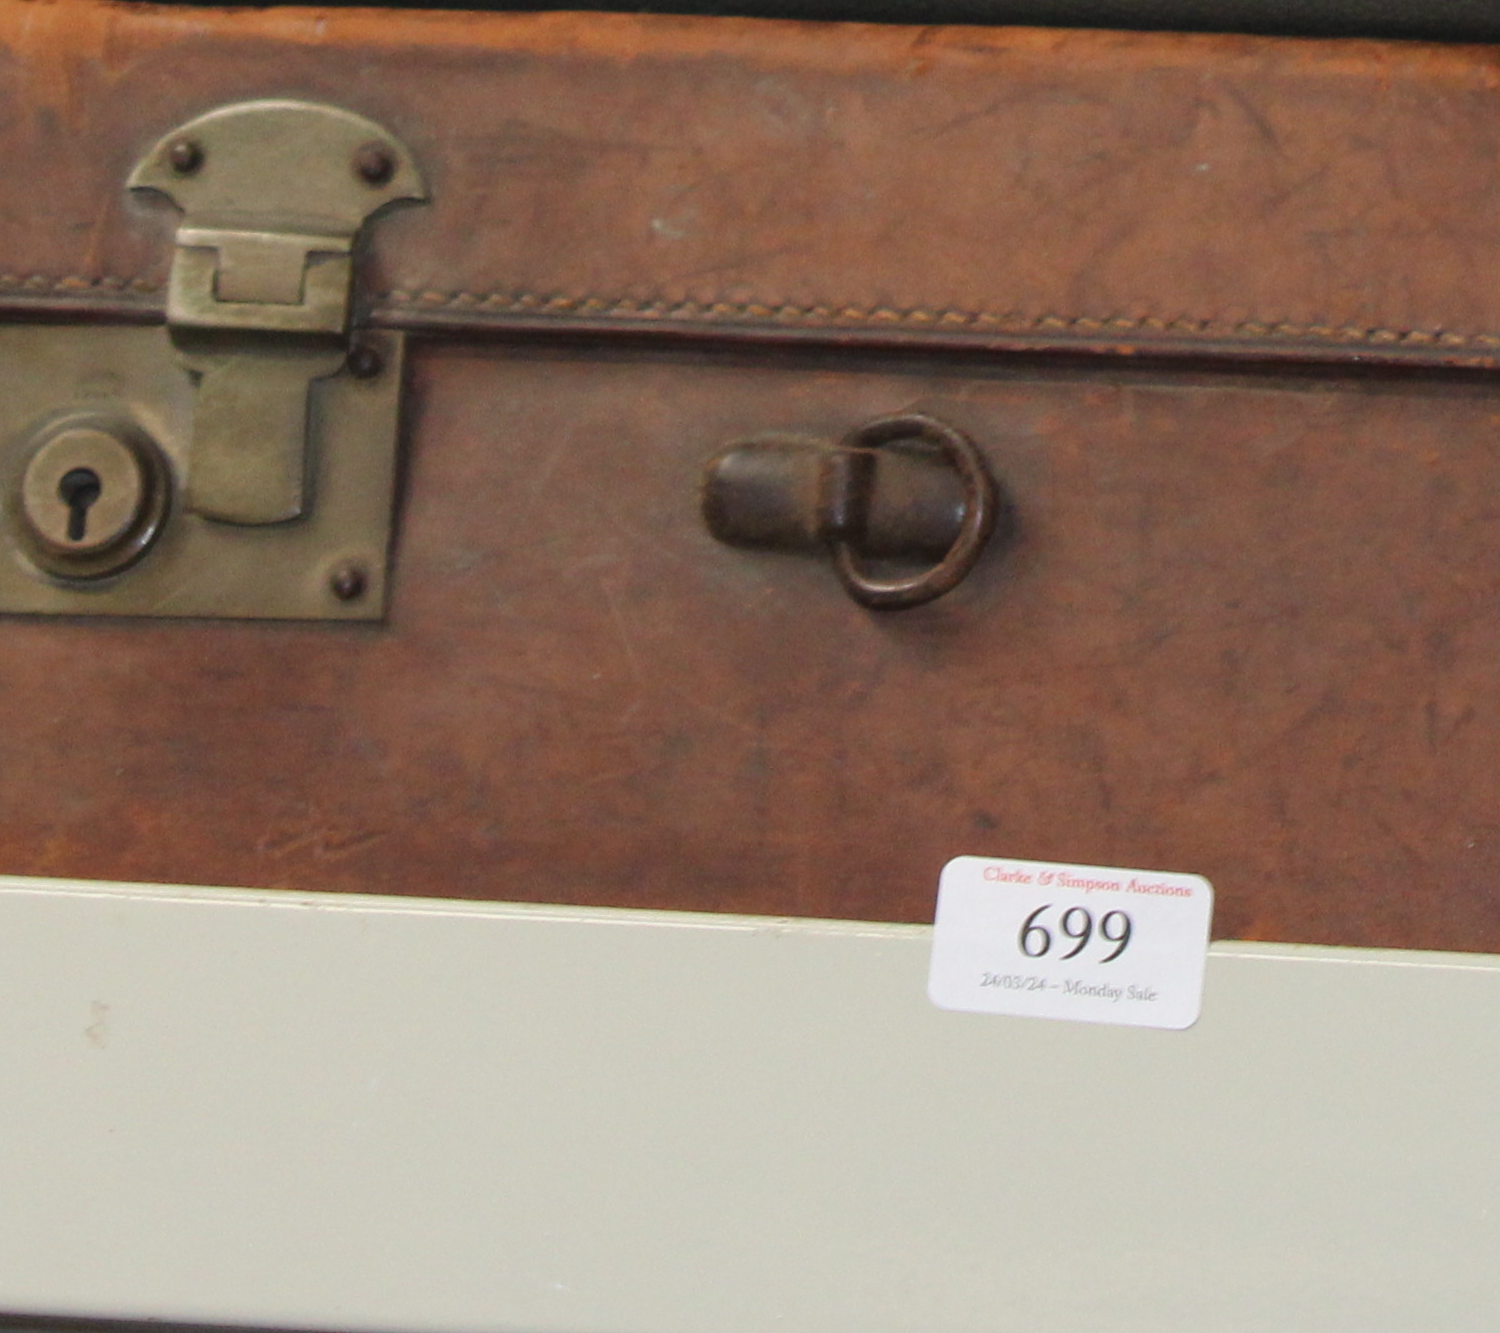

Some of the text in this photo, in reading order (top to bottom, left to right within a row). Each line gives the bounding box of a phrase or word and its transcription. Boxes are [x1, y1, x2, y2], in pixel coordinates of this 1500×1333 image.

[983, 866, 1032, 884] Clarke
[1056, 872, 1121, 894] Simpson
[1125, 878, 1193, 898] Auctions
[1018, 904, 1133, 965] 699
[1062, 979, 1123, 1003] Monday
[1127, 984, 1159, 1002] Sale
